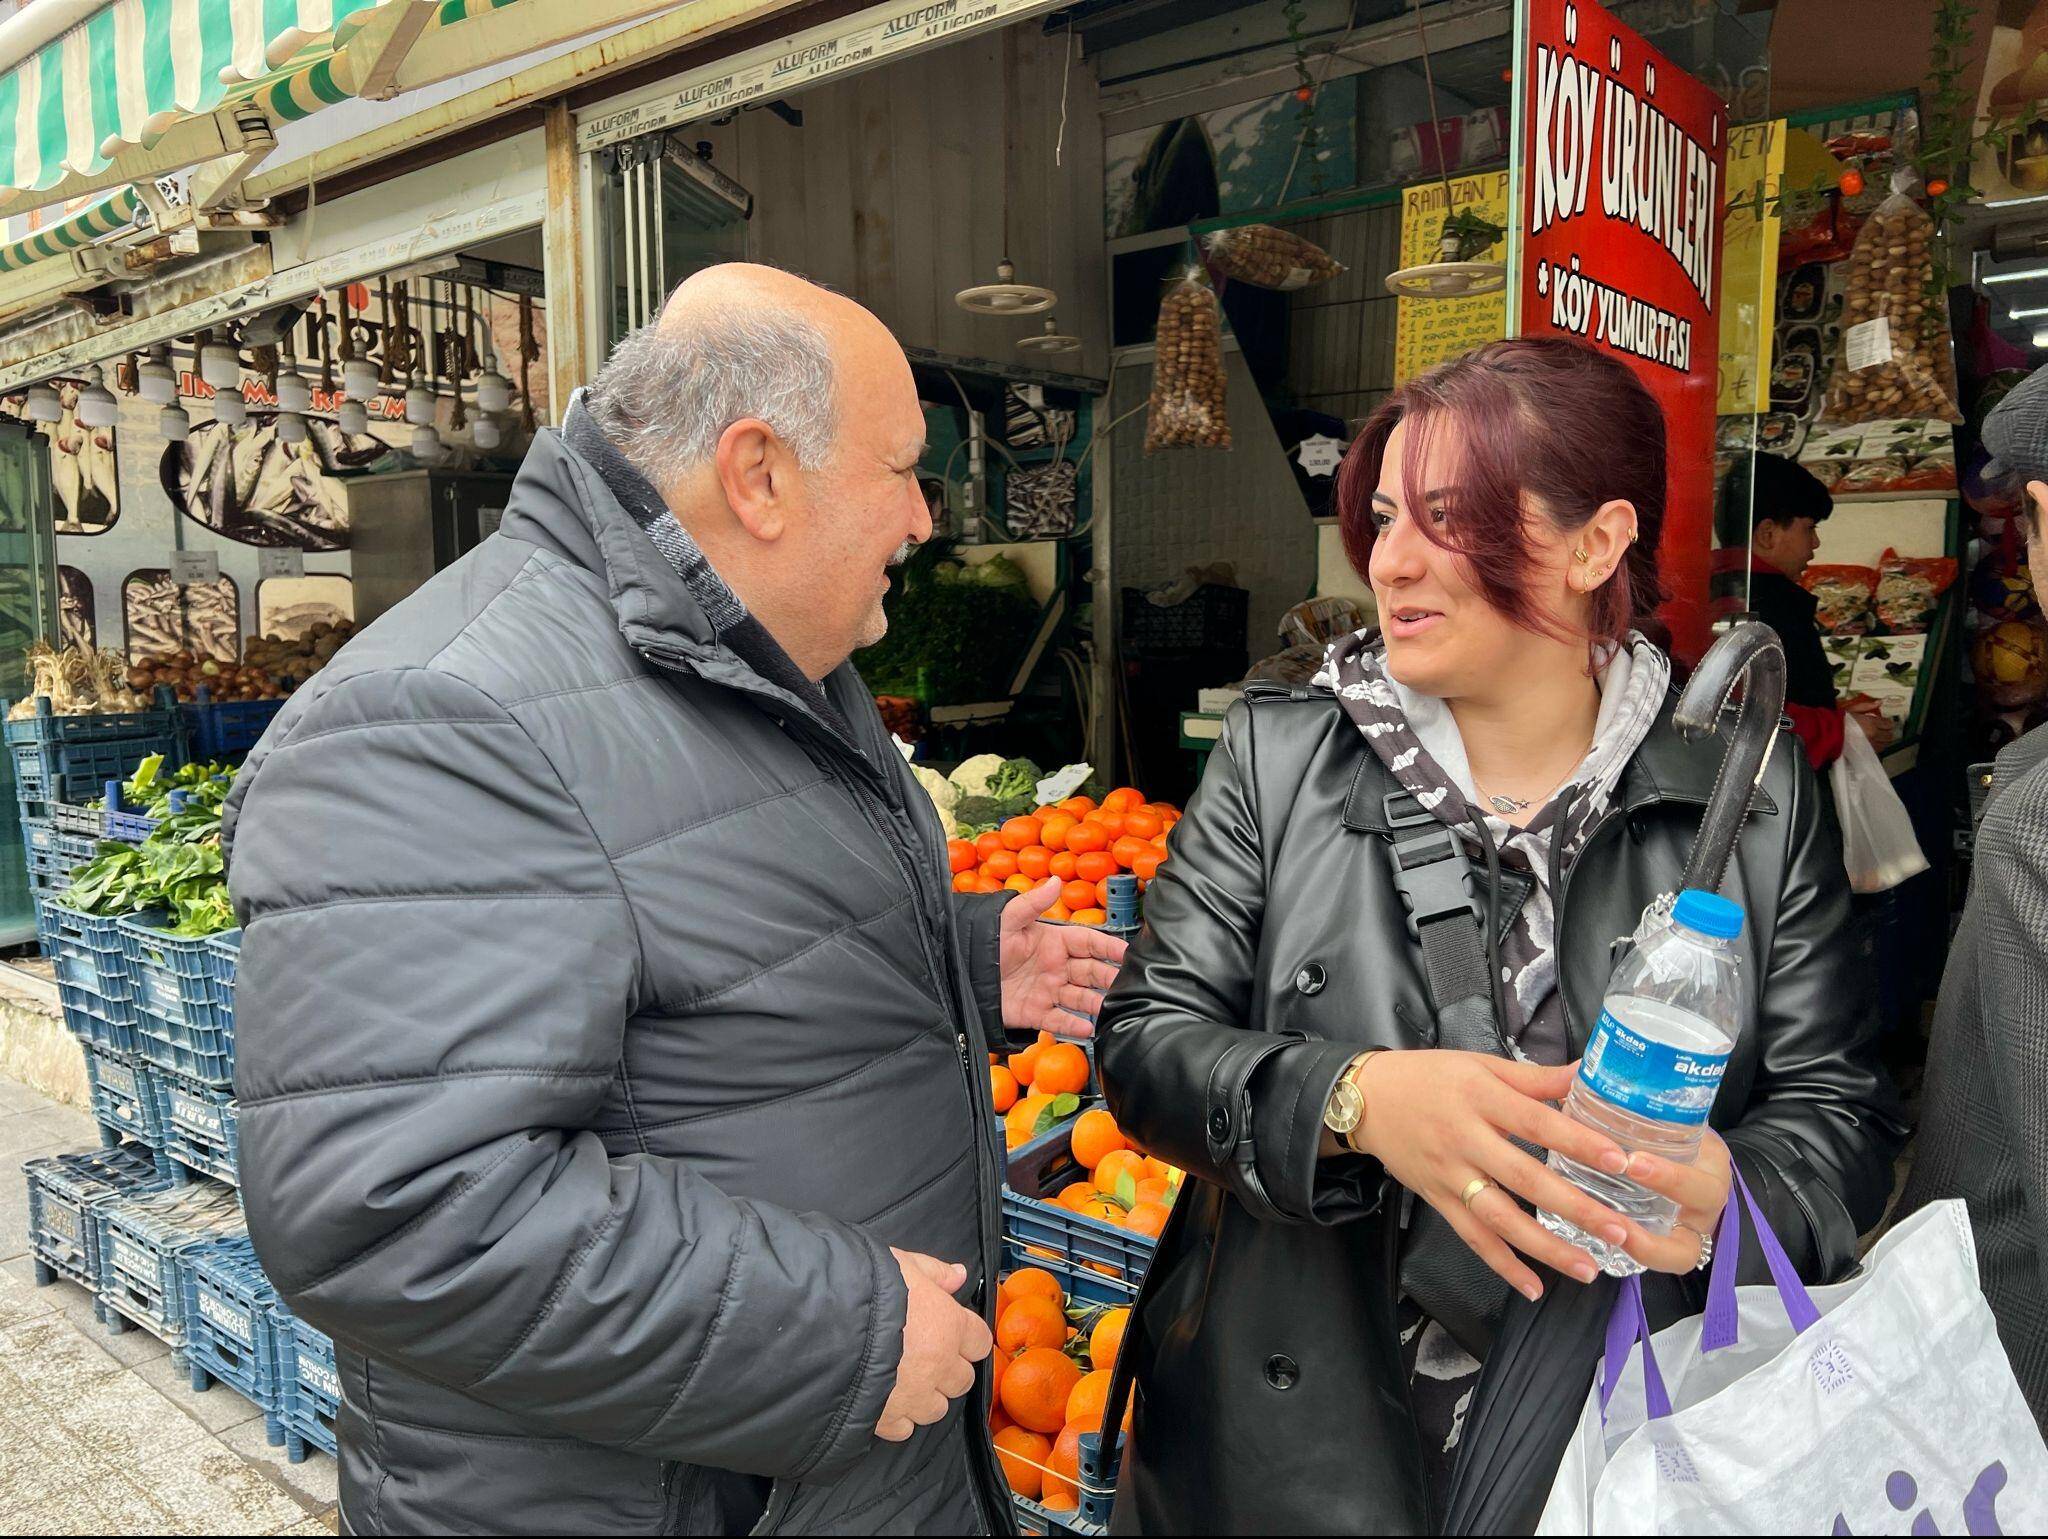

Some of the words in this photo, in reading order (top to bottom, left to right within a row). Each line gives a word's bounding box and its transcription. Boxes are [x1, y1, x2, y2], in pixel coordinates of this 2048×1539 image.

[884, 1, 957, 36] ALUFORM
[775, 40, 837, 73] ALUFORM
[676, 77, 733, 106] ALUFORM
[589, 108, 640, 135] ALUFORM
[1532, 4, 1600, 233] KÖY
[1602, 38, 1718, 312] ÜRÜNLERİ
[1407, 177, 1485, 216] RAMZAN
[1552, 256, 1596, 334] KÖY
[1596, 284, 1691, 371] YUMURTASI
